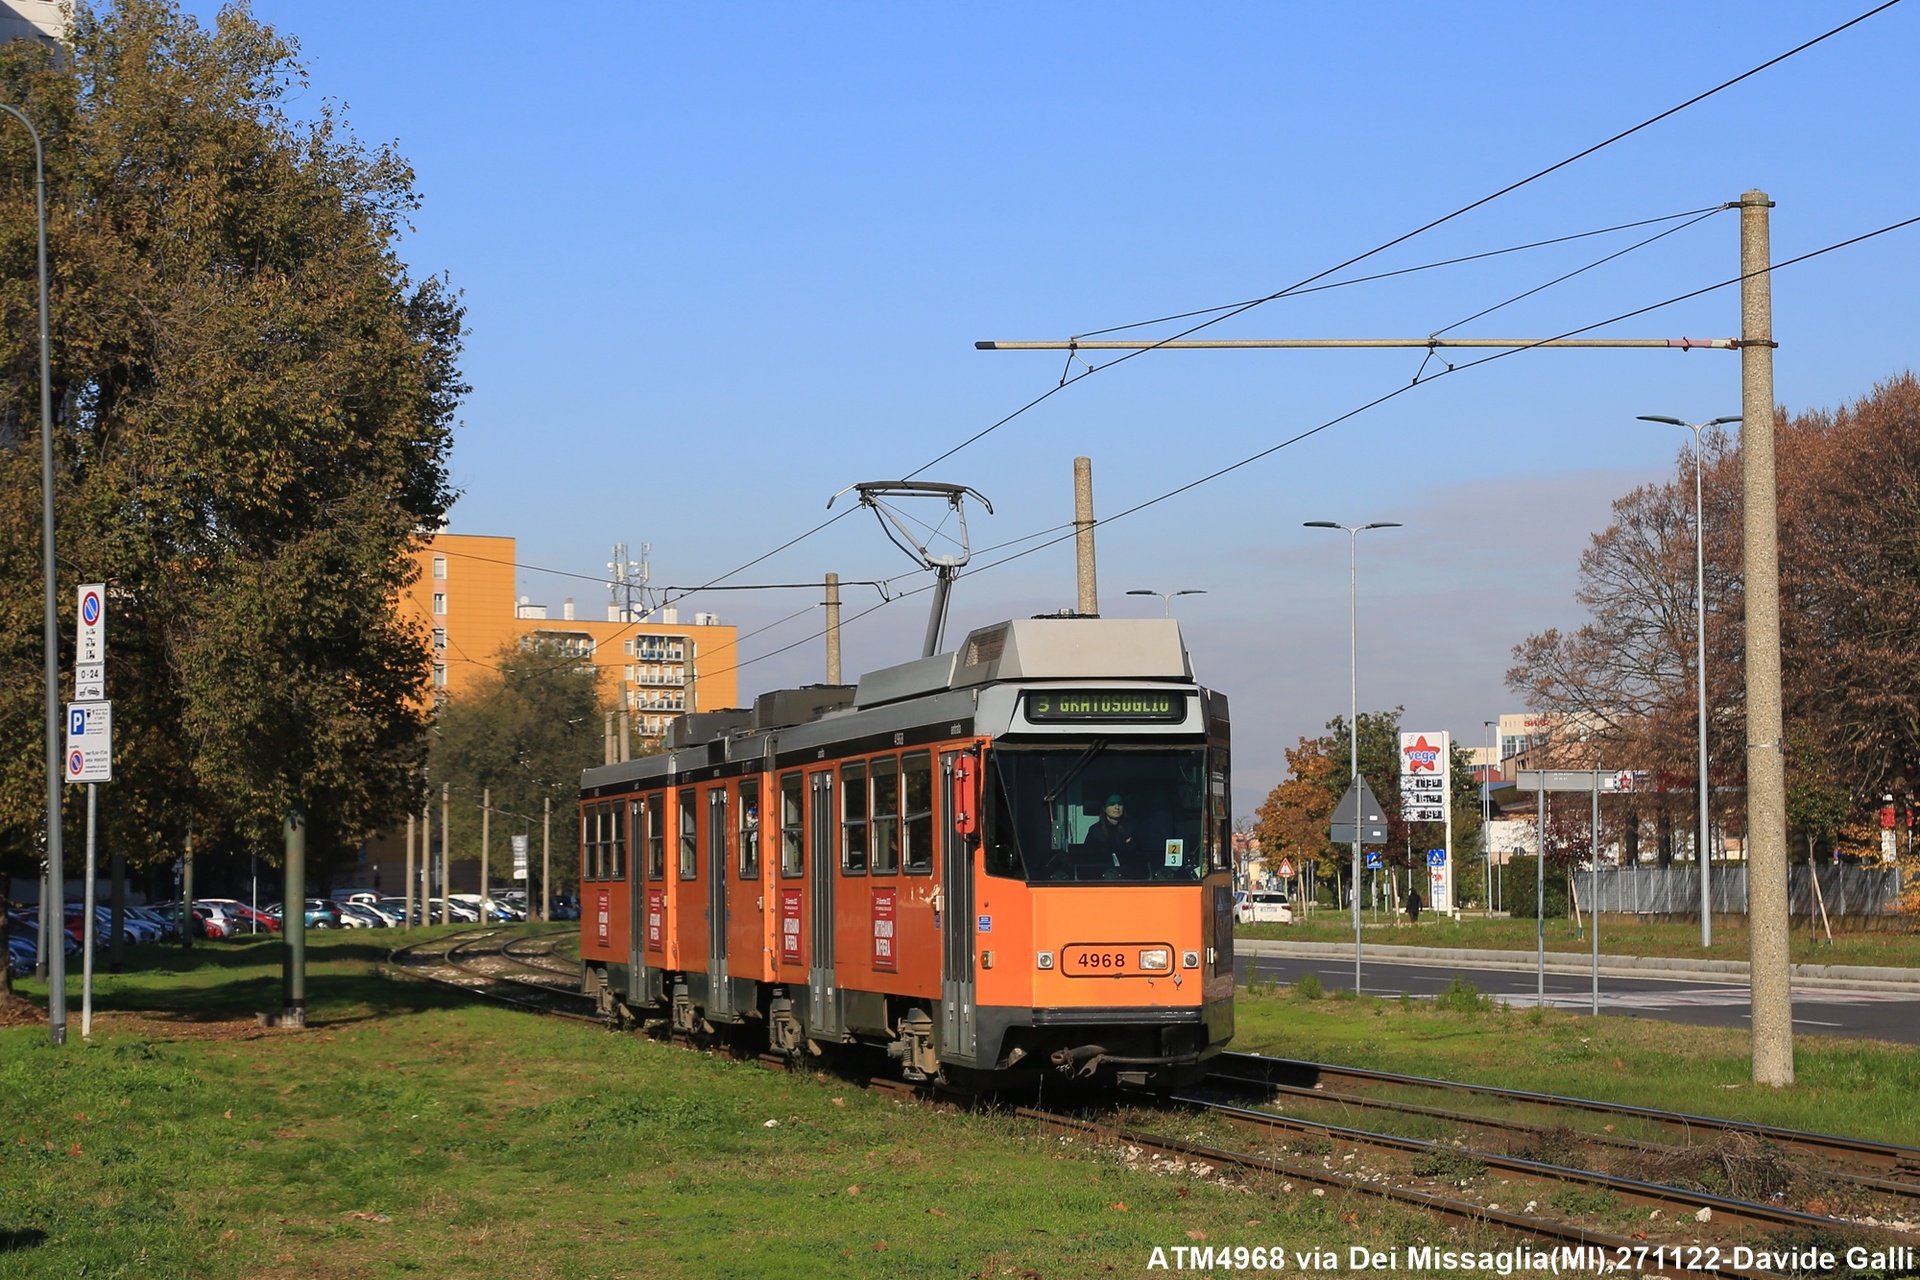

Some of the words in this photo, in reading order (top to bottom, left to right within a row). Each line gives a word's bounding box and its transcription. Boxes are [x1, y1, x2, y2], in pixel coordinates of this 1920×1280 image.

[1037, 696, 1050, 713] 3
[1060, 695, 1169, 713] GRATOSOGLIO
[73, 712, 83, 733] P
[1408, 751, 1437, 763] vega
[1171, 844, 1177, 854] 2
[1171, 855, 1177, 865] 3
[1078, 953, 1125, 968] 4968
